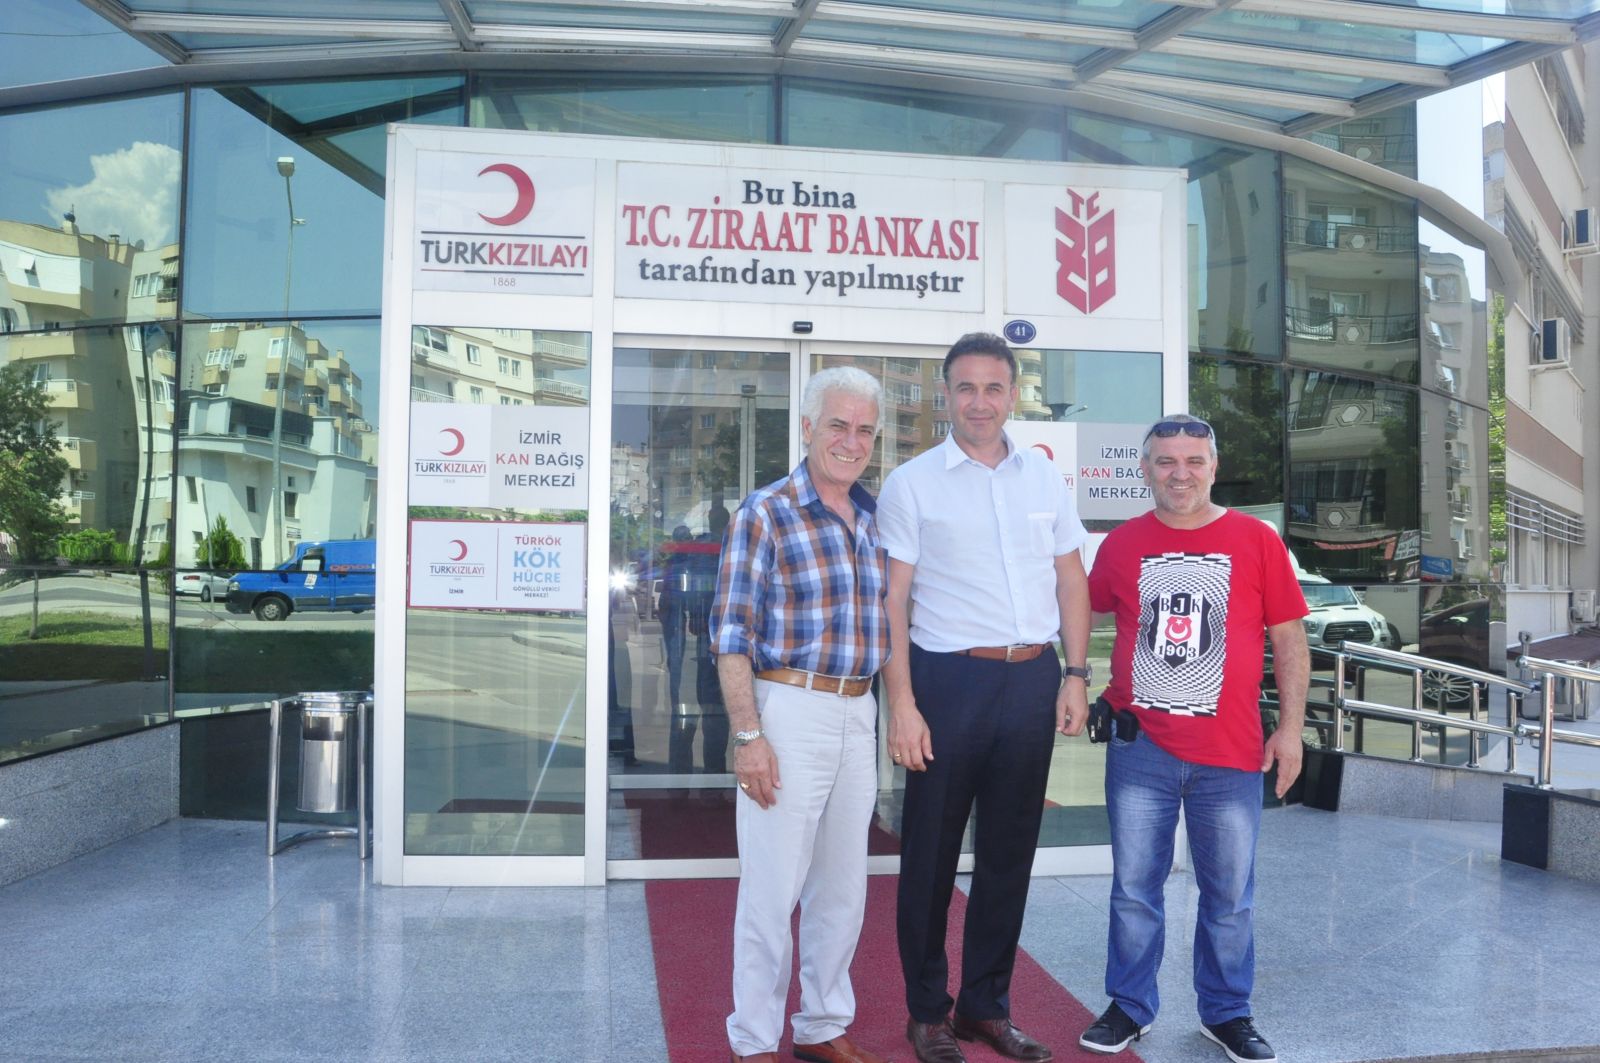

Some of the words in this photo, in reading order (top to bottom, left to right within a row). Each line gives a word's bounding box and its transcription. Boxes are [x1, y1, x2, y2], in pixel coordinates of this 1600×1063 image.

[742, 179, 784, 206] Bu
[792, 181, 857, 210] bina
[622, 204, 681, 248] T.C.
[687, 195, 817, 254] ZİRAAT
[827, 213, 979, 261] BANKASI
[492, 277, 516, 287] 1868
[638, 256, 797, 286] tarafından
[804, 264, 964, 299] yapılmıştır
[1014, 325, 1026, 337] 41
[519, 430, 561, 445] İZMİR
[1101, 445, 1138, 459] İZMİR
[495, 453, 529, 465] KAN
[535, 452, 584, 470] BAĞIŞ
[1081, 467, 1111, 478] KAN
[504, 473, 575, 487] MERKEZİ
[515, 535, 562, 546] TÜRKÖK
[514, 547, 561, 569] KÖK
[513, 569, 561, 584] HÜCRE
[1158, 645, 1197, 658] 1903
